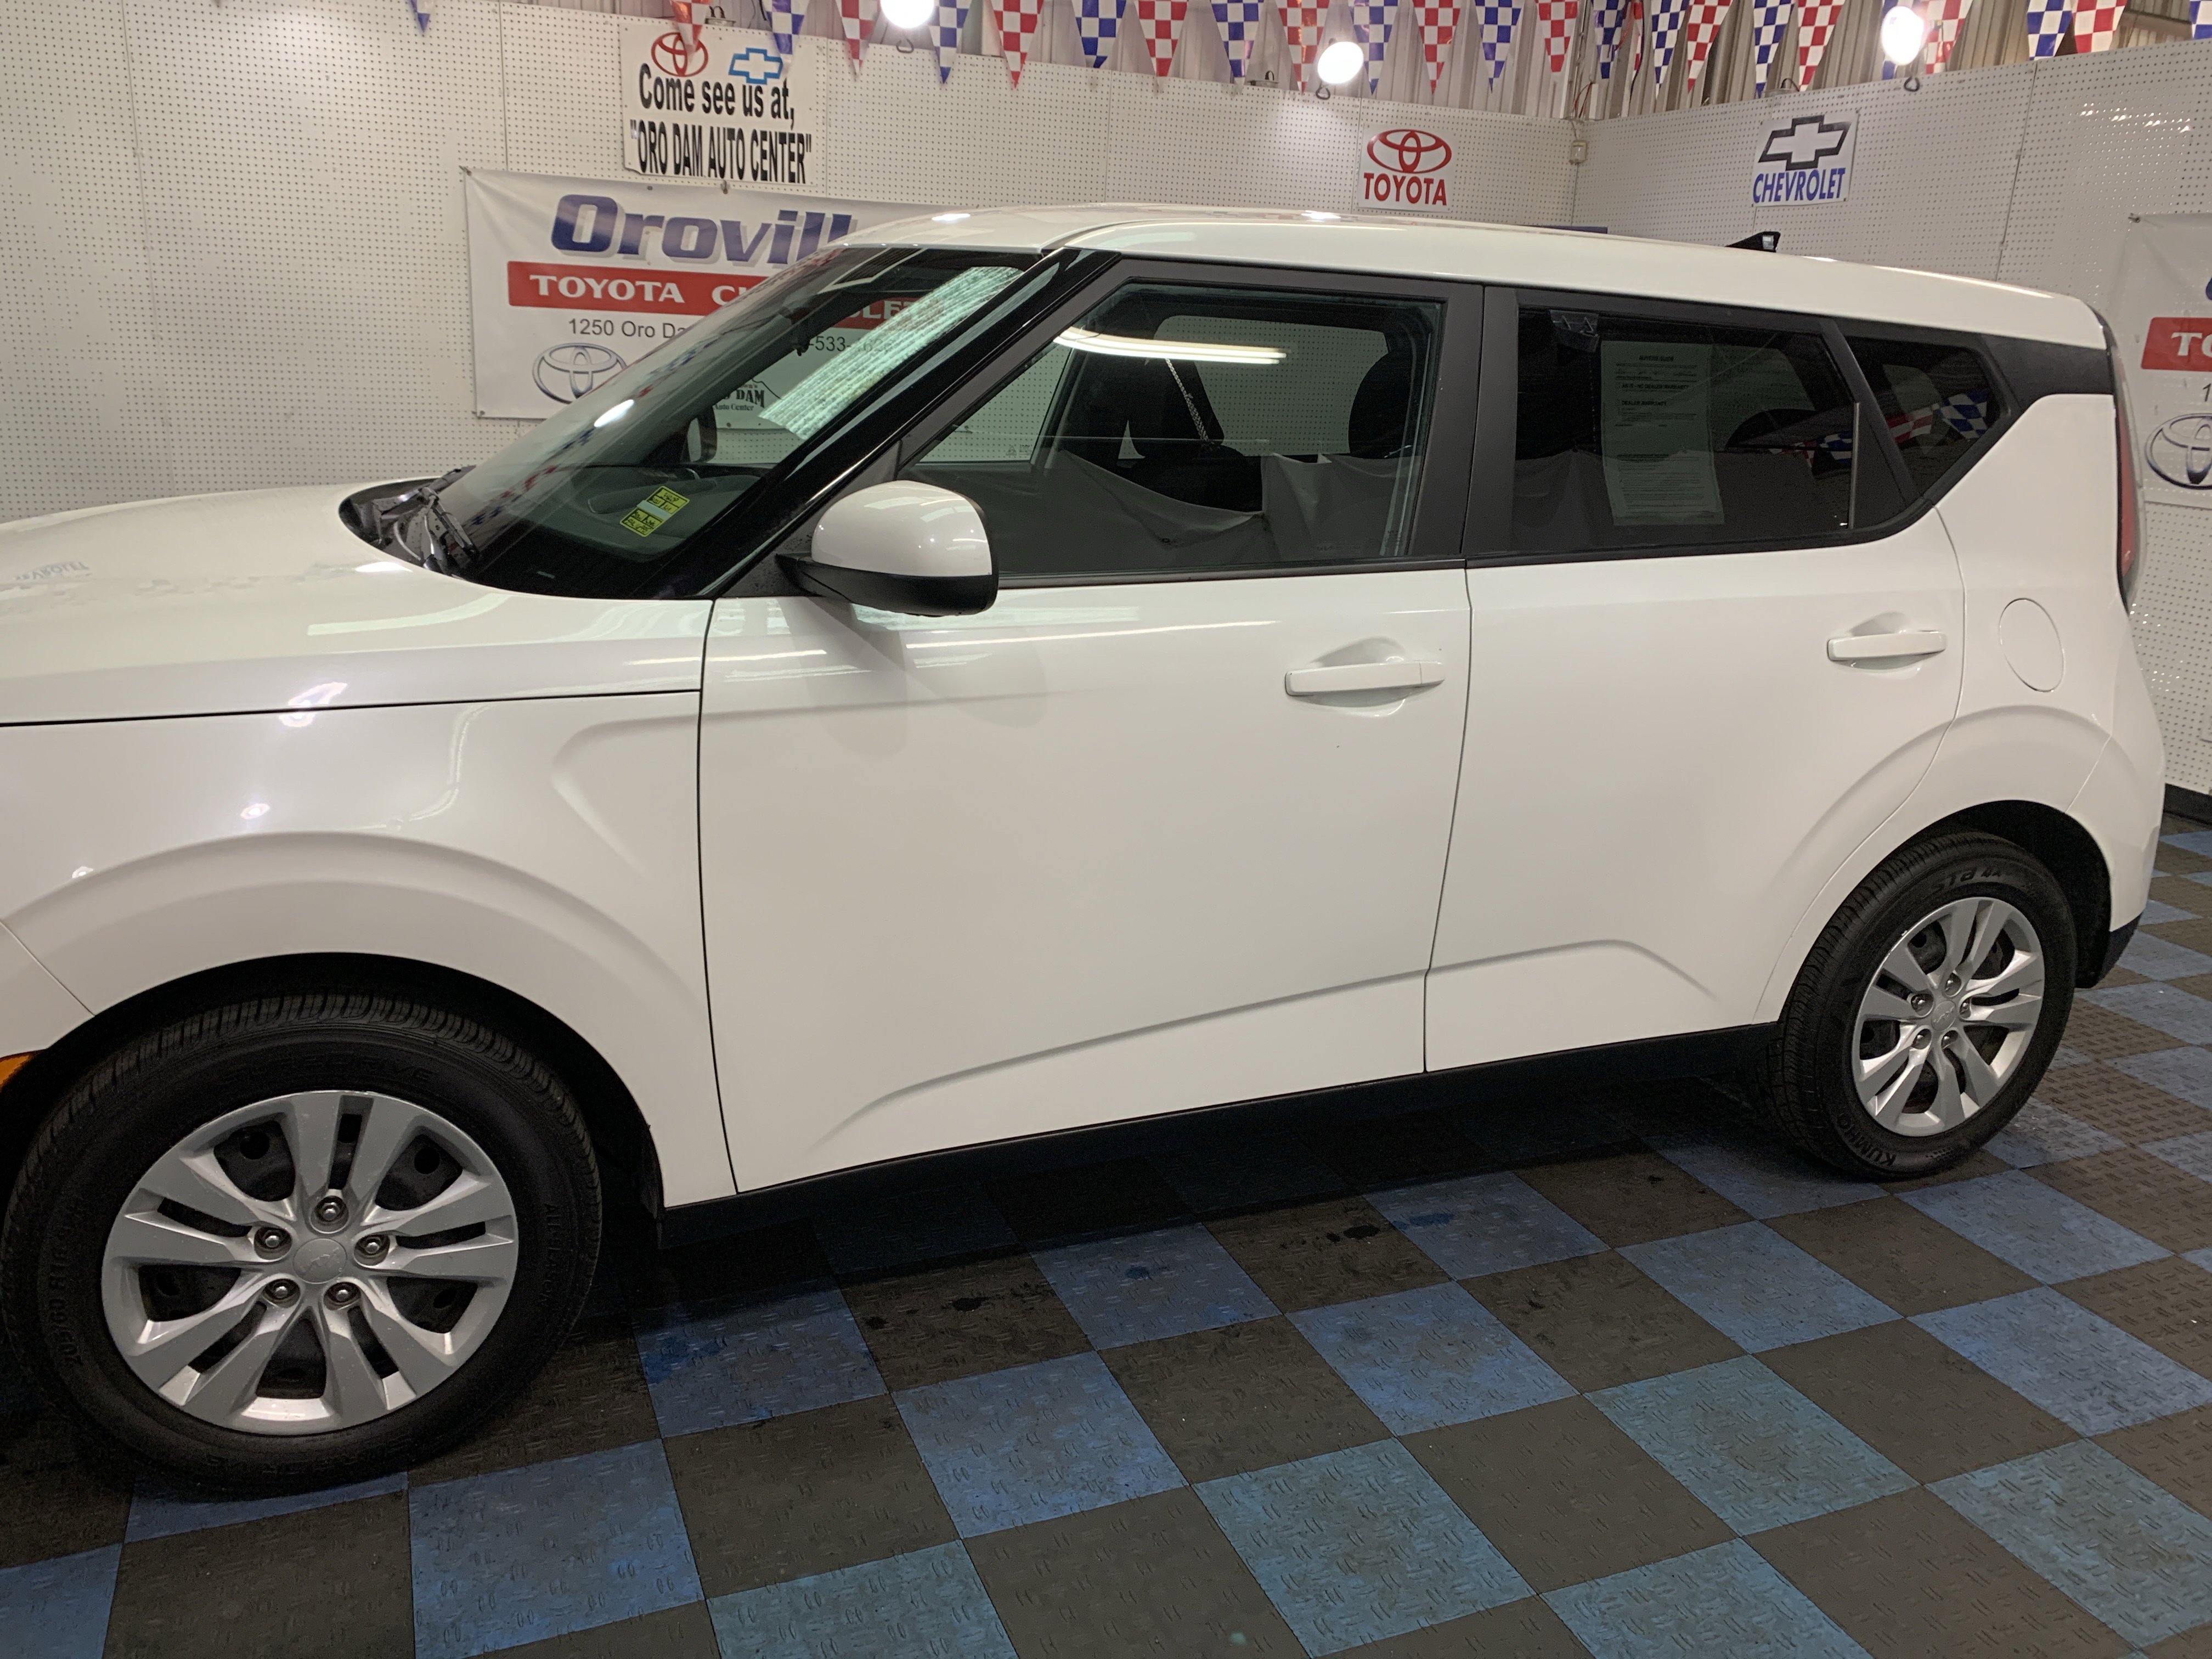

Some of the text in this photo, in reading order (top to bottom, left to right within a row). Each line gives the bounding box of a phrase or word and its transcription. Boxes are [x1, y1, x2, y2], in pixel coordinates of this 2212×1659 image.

[639, 63, 794, 131] Come see us at,
[630, 119, 812, 184] "ORO DAM AUTO CENTER"
[1364, 172, 1447, 206] TOYOTA
[1753, 167, 1846, 204] CHEVROLET
[550, 194, 854, 264] Orovill
[529, 274, 685, 303] TOYOTA
[568, 318, 614, 336] 1250
[622, 321, 656, 338] Oro
[736, 389, 765, 409] DAM
